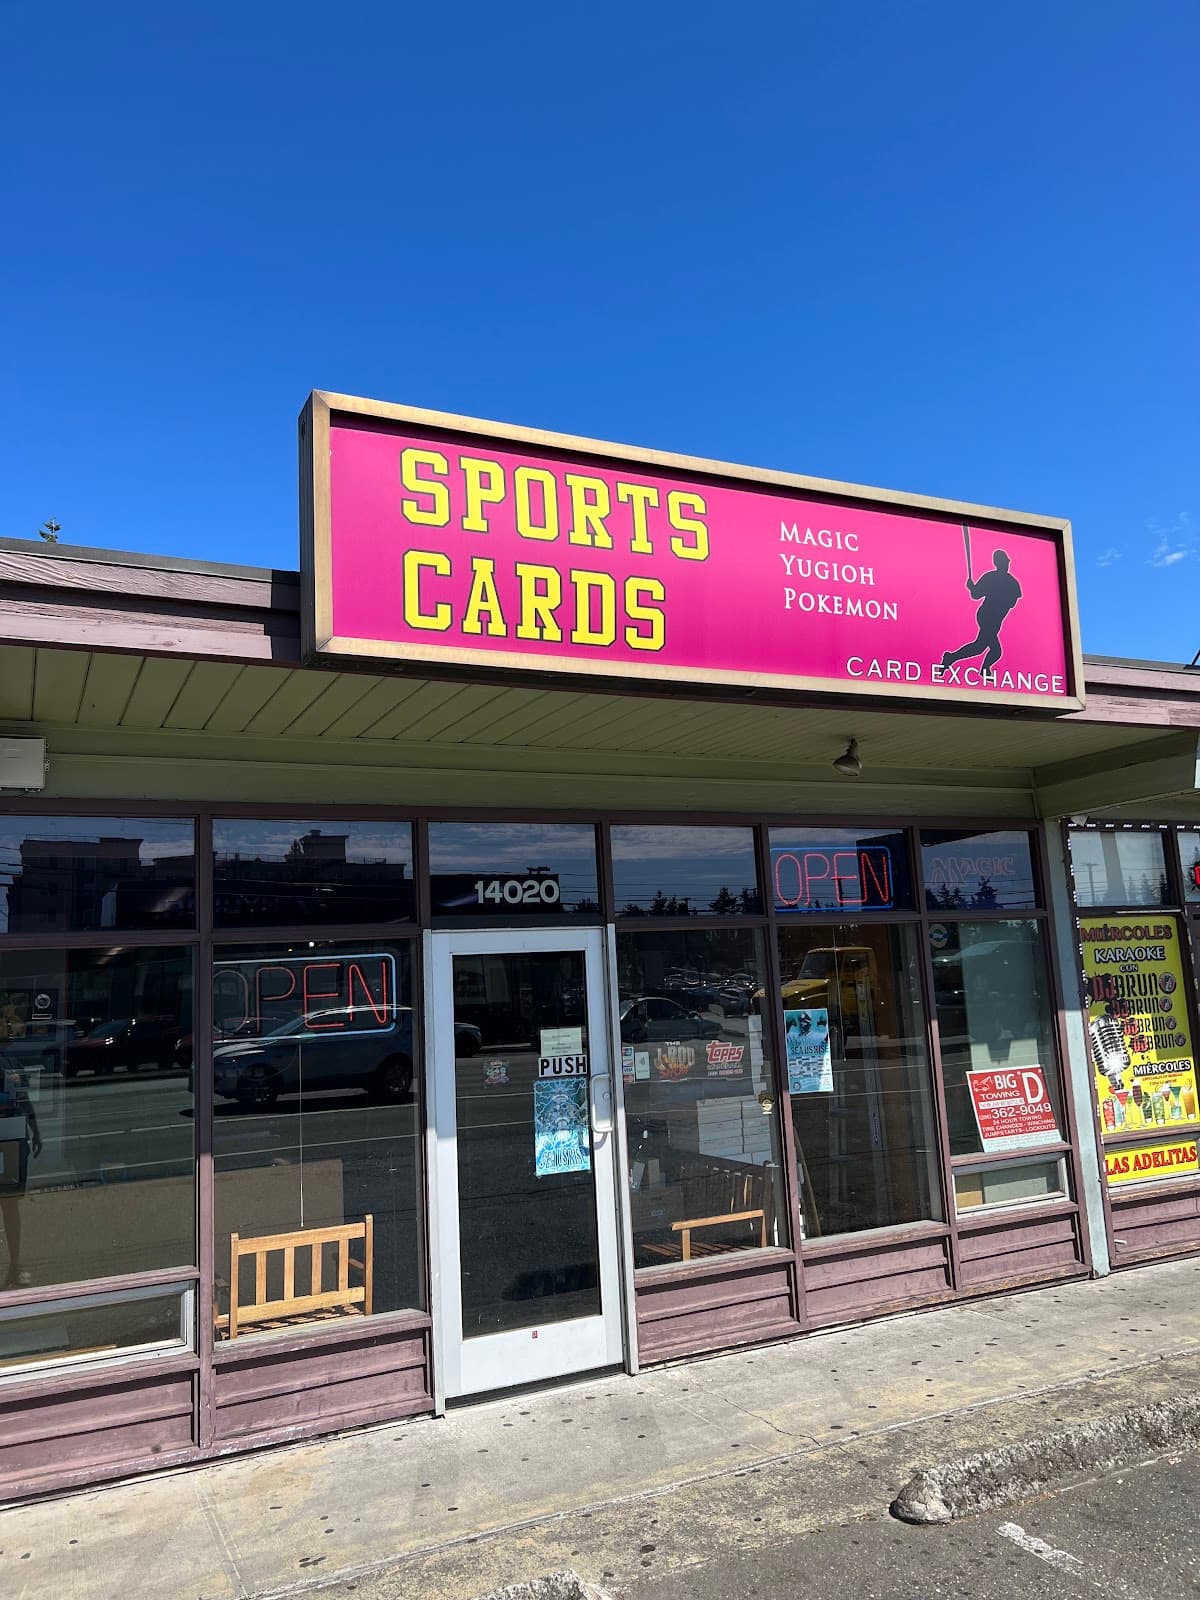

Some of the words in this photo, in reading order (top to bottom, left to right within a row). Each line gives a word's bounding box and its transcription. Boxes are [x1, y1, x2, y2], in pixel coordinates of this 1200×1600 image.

[401, 447, 710, 561] SPORTS
[779, 520, 859, 552] MAGIC
[780, 554, 876, 586] YUGIOH
[403, 550, 666, 652] CARDS
[784, 587, 898, 621] POKEMON
[846, 656, 921, 682] CARD
[931, 663, 1065, 694] EXCHANGE
[775, 852, 889, 906] OPEN
[928, 856, 1017, 888] MAGIC
[474, 879, 560, 904] 14020
[1080, 924, 1173, 943] MIÉRCOLES
[1094, 946, 1166, 963] KARAOKE
[1119, 964, 1139, 972] CON
[213, 961, 388, 1035] OPEN
[540, 1056, 587, 1075] PUSH
[1133, 1060, 1191, 1076] MIÉRCOLES
[980, 1090, 1021, 1100] TOWING
[994, 1073, 1018, 1090] BIG
[991, 1102, 1052, 1119] 362-9049
[1105, 1156, 1130, 1176] LAS
[1133, 1145, 1198, 1172] ADELITAS
